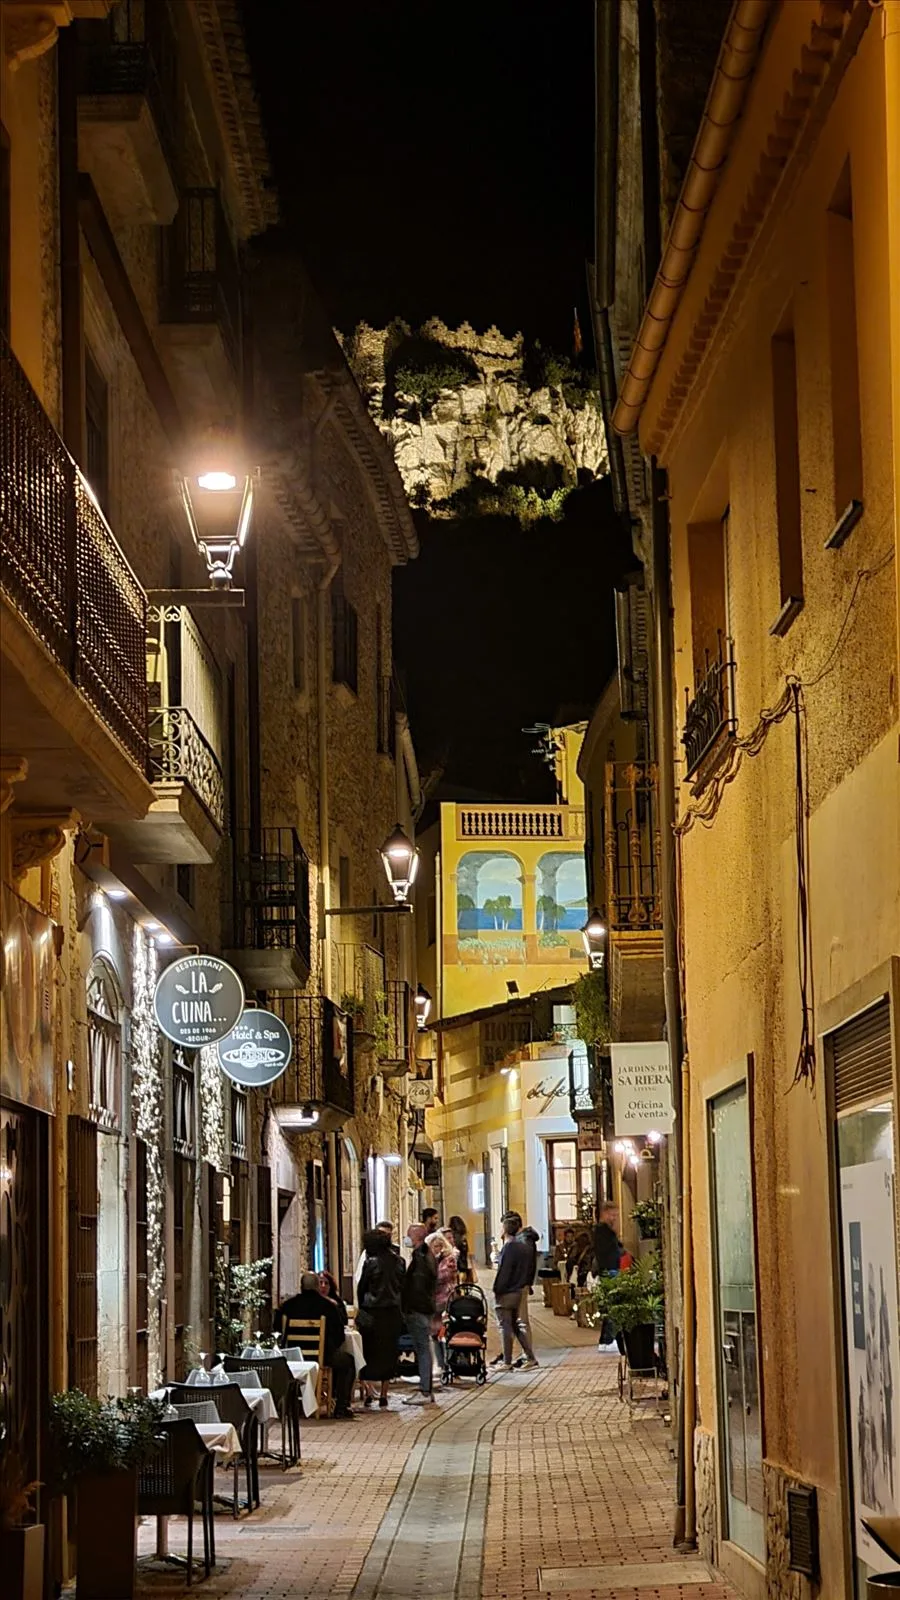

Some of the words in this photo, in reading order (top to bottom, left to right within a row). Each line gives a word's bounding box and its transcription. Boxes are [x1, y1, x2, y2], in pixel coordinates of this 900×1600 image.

[175, 959, 224, 973] RESTAURANT
[191, 971, 207, 994] LA
[180, 1027, 191, 1035] DES
[231, 1028, 255, 1040] Hotel
[255, 1031, 263, 1039] &
[263, 1029, 281, 1042] Spa
[618, 1064, 656, 1075] JARDINS
[617, 1075, 632, 1086] SA
[635, 1074, 672, 1086] RIERA
[628, 1100, 664, 1110] Oficina
[624, 1110, 636, 1119] de
[638, 1109, 669, 1119] ventas
